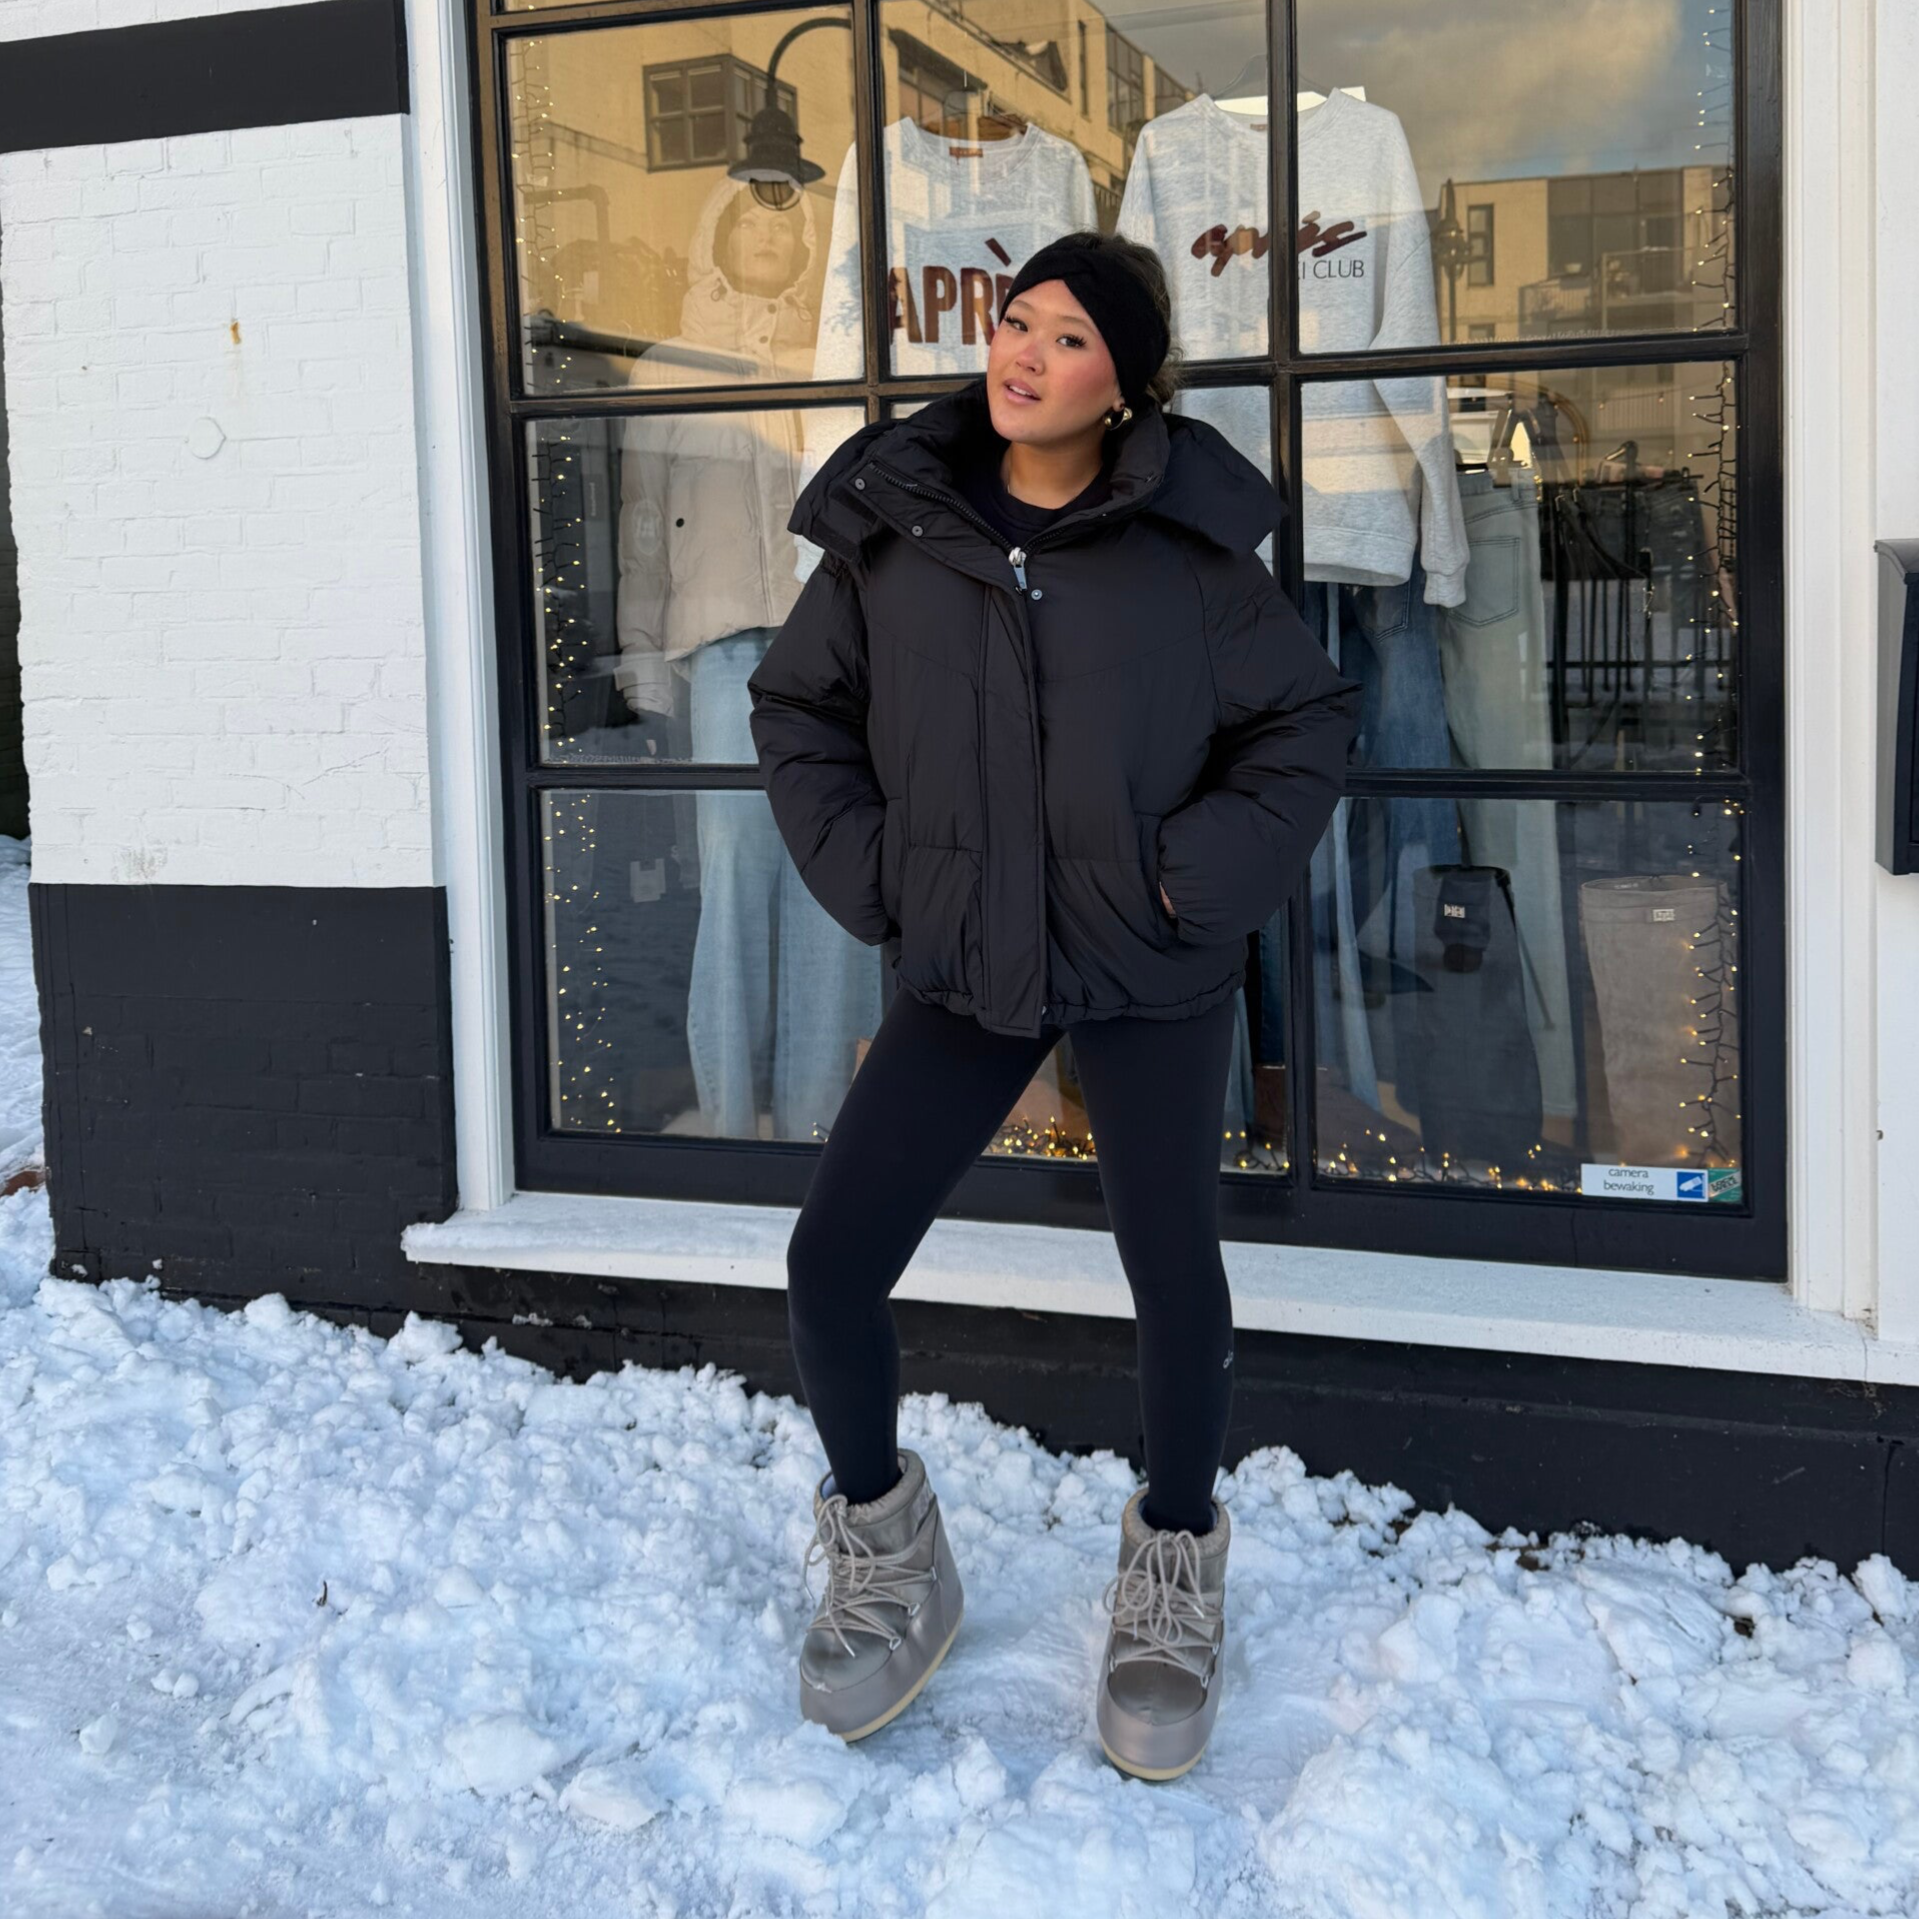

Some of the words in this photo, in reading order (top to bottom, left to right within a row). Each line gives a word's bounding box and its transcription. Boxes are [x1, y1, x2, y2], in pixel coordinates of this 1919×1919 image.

[1313, 260, 1364, 279] CLUB
[1608, 1168, 1649, 1179] camera
[1603, 1180, 1655, 1196] bewaking
